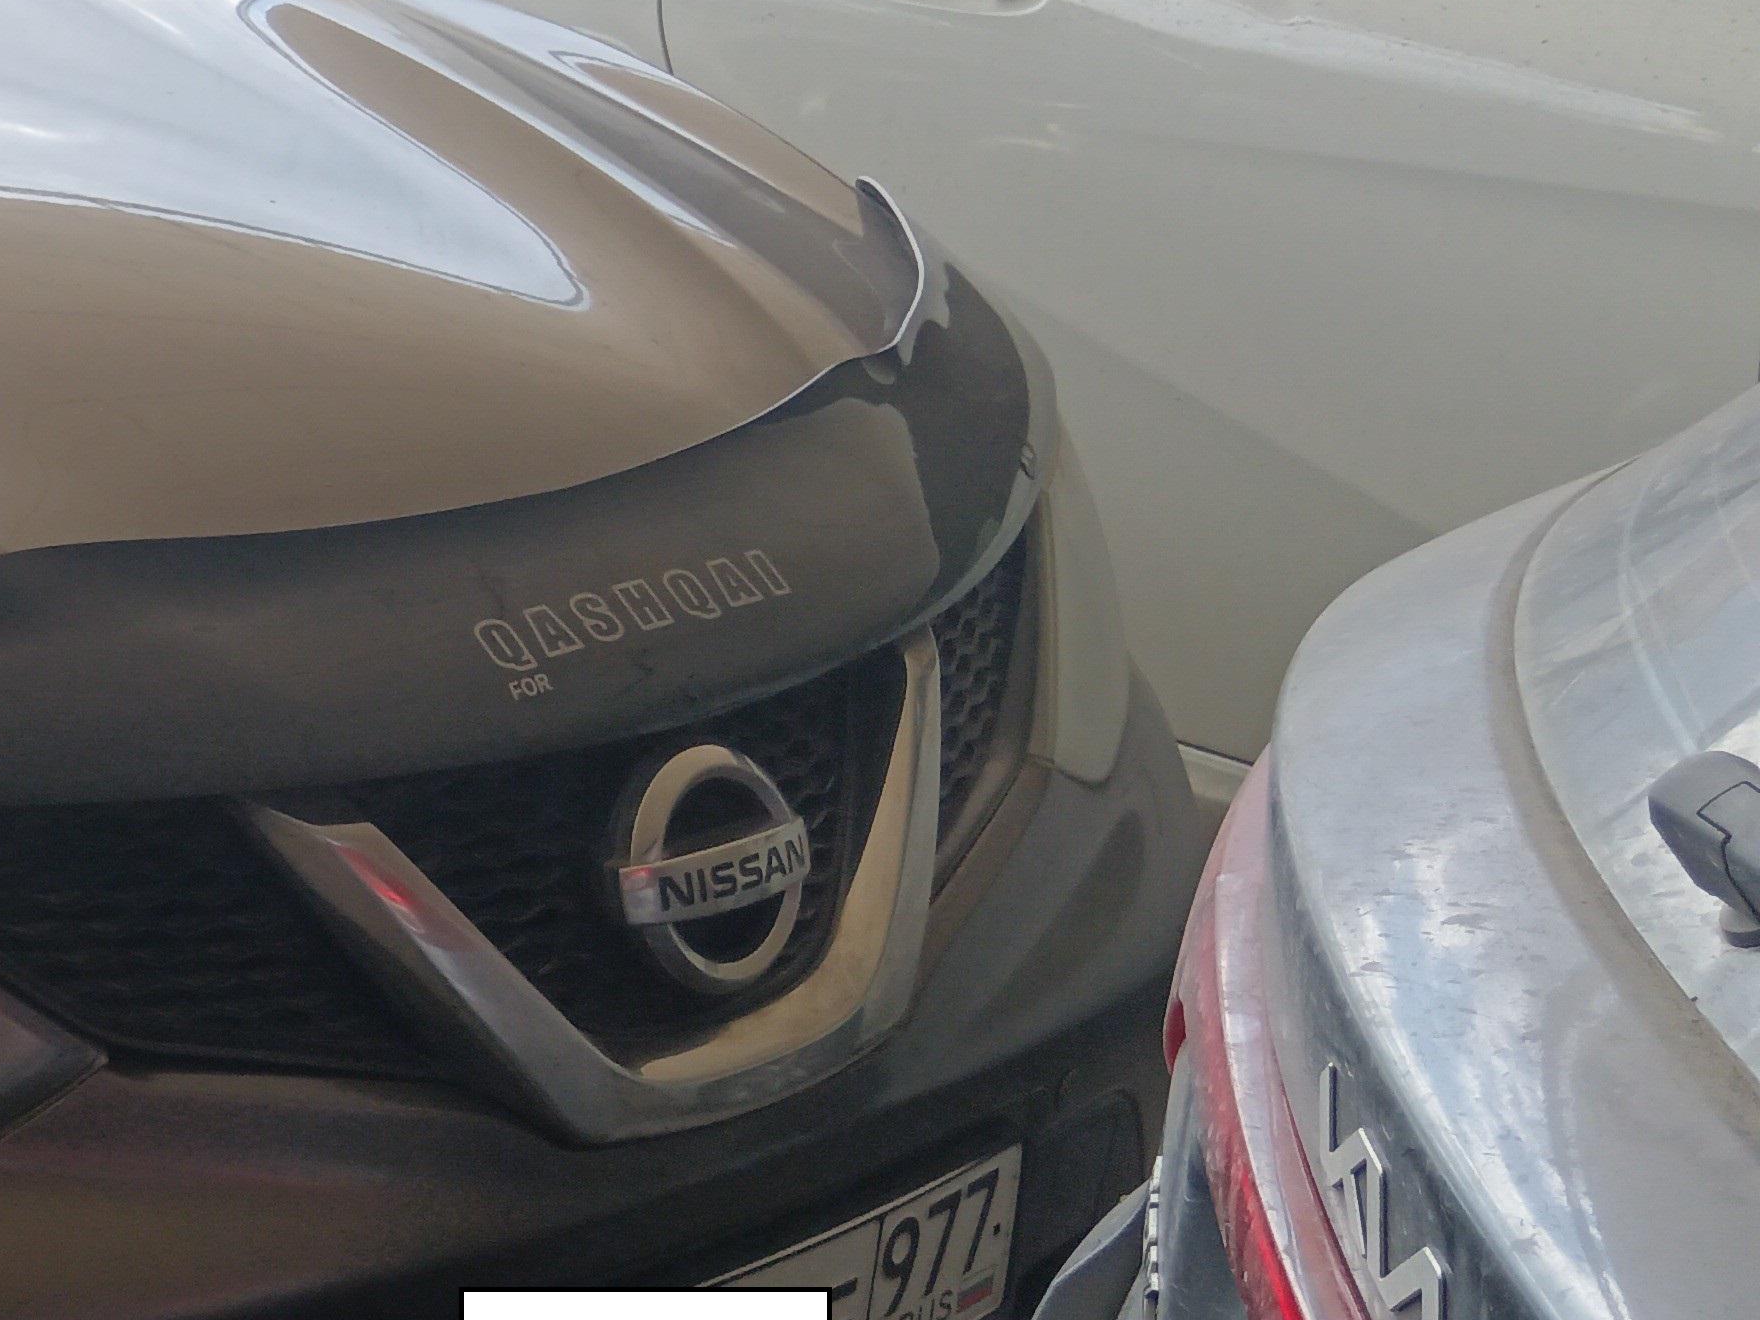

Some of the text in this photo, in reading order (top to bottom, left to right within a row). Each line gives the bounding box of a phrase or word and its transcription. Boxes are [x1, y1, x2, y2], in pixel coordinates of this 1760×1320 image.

[474, 549, 792, 671] QASHQAI
[508, 673, 554, 701] FOR
[658, 833, 806, 911] NISSAN
[881, 1168, 1000, 1318] 977
